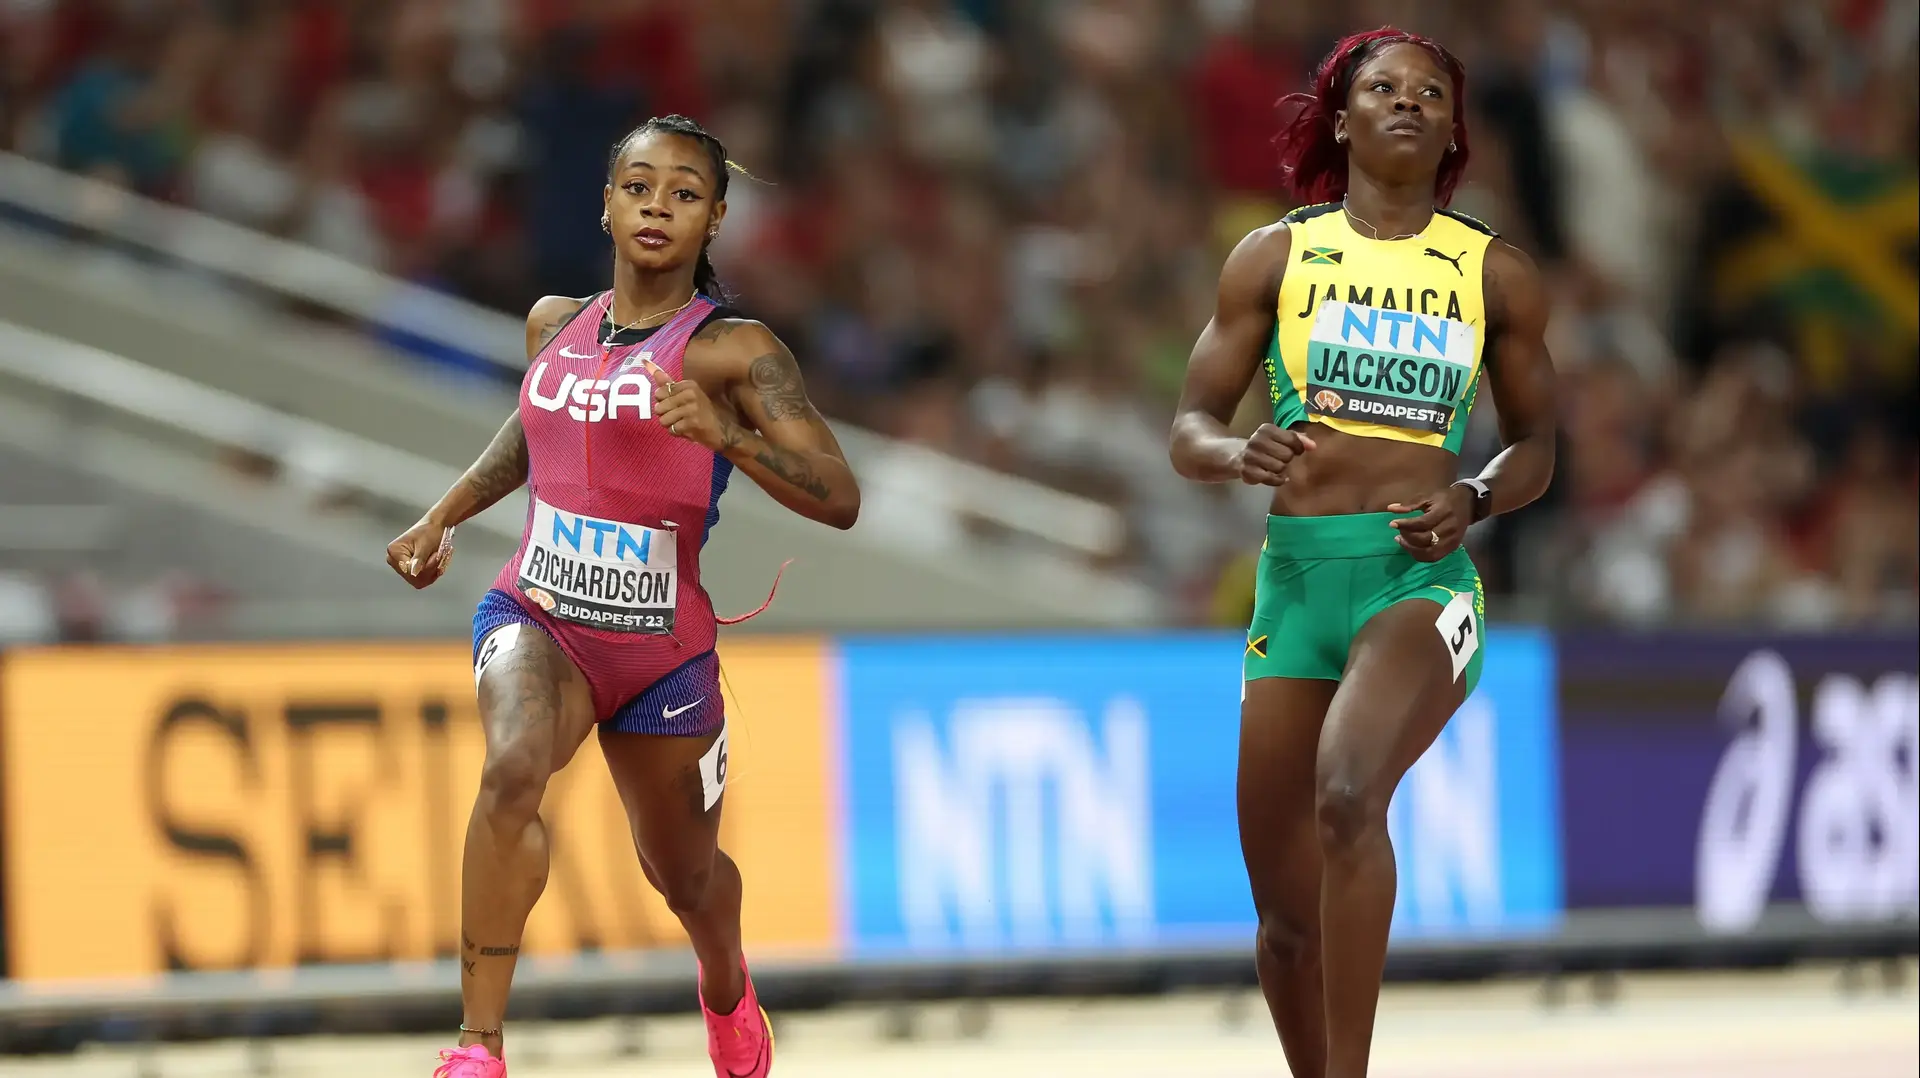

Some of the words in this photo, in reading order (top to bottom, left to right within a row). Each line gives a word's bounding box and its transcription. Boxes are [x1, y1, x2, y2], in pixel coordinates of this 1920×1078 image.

[1341, 304, 1449, 357] NTN
[527, 361, 652, 423] USA
[1313, 347, 1462, 402] JACKSON
[1348, 398, 1438, 423] BUDAPEST
[552, 511, 652, 566] NTN
[526, 545, 671, 604] RICHARDSON
[559, 602, 644, 627] BUDAPEST
[645, 615, 665, 628] 23
[1450, 614, 1473, 656] 5
[480, 638, 499, 671] 6
[716, 740, 728, 785] 6
[890, 695, 1155, 950] NTN
